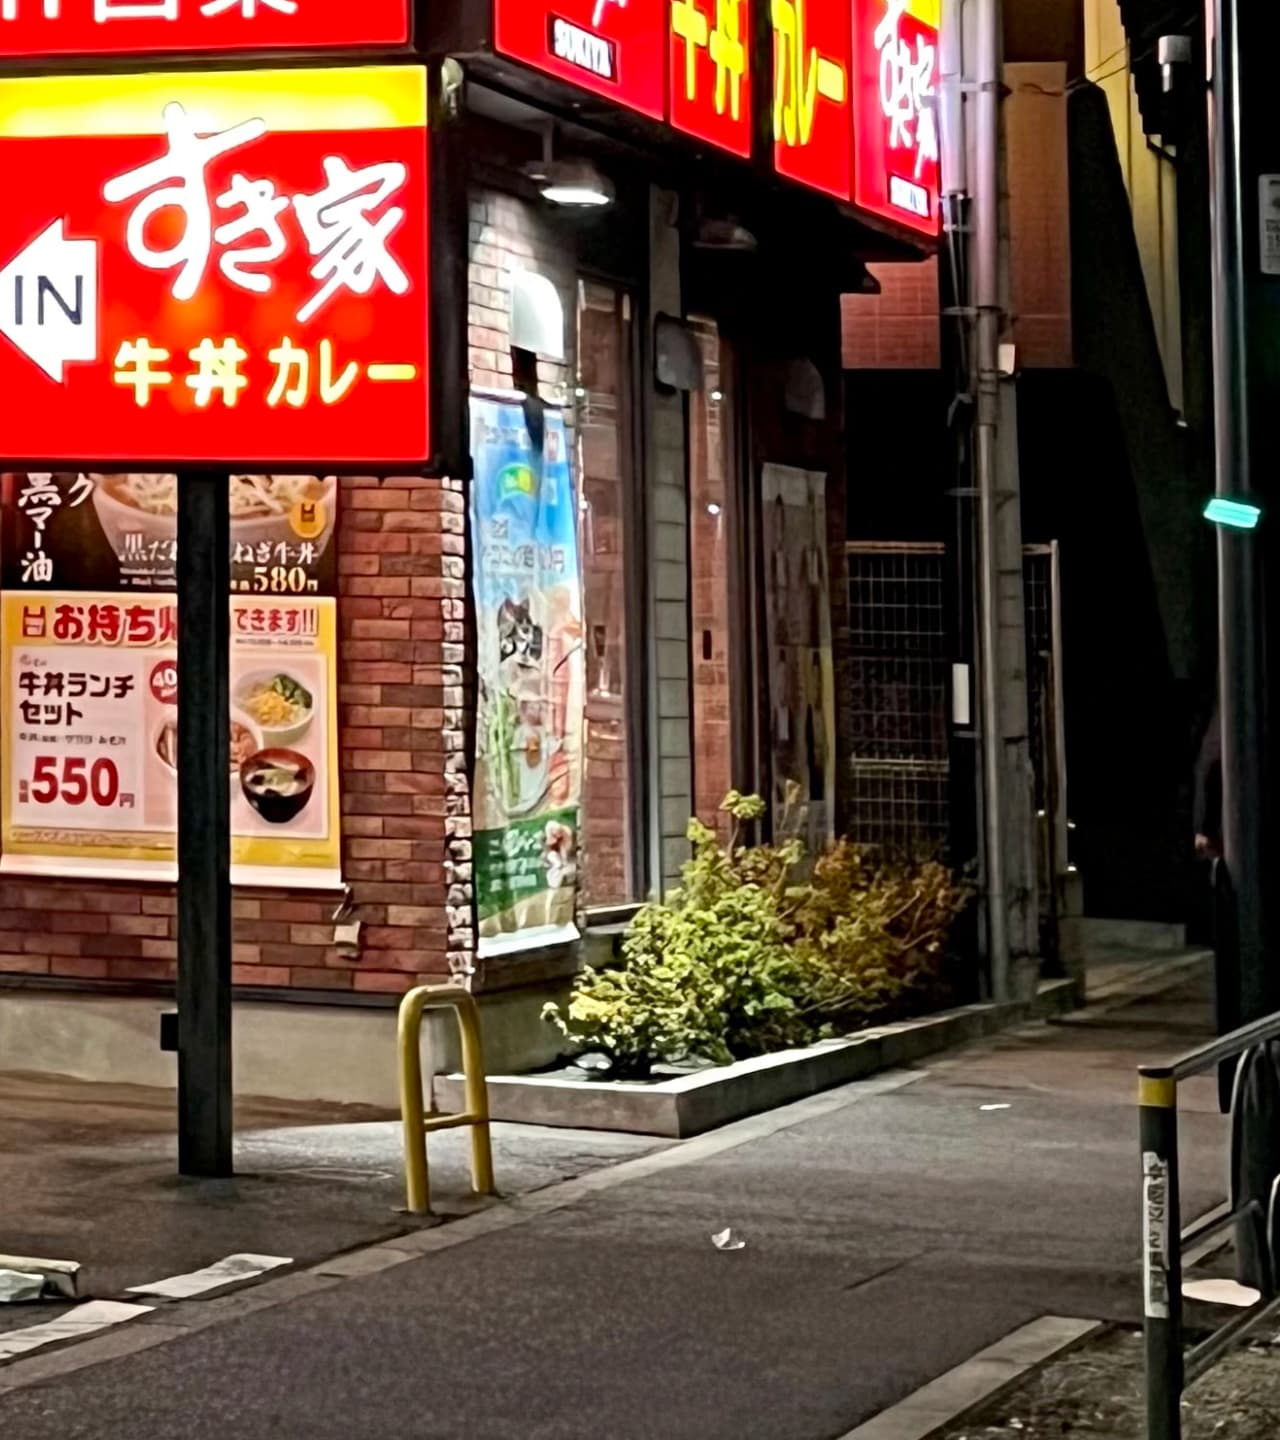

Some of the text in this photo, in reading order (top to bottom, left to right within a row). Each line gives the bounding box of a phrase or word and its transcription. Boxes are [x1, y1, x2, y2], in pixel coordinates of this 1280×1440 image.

[103, 101, 409, 322] すき家
[14, 275, 83, 325] IN
[113, 336, 417, 408] 牛丼 カレー
[18, 671, 135, 699] 牛丼ランチ
[18, 699, 84, 727] セット
